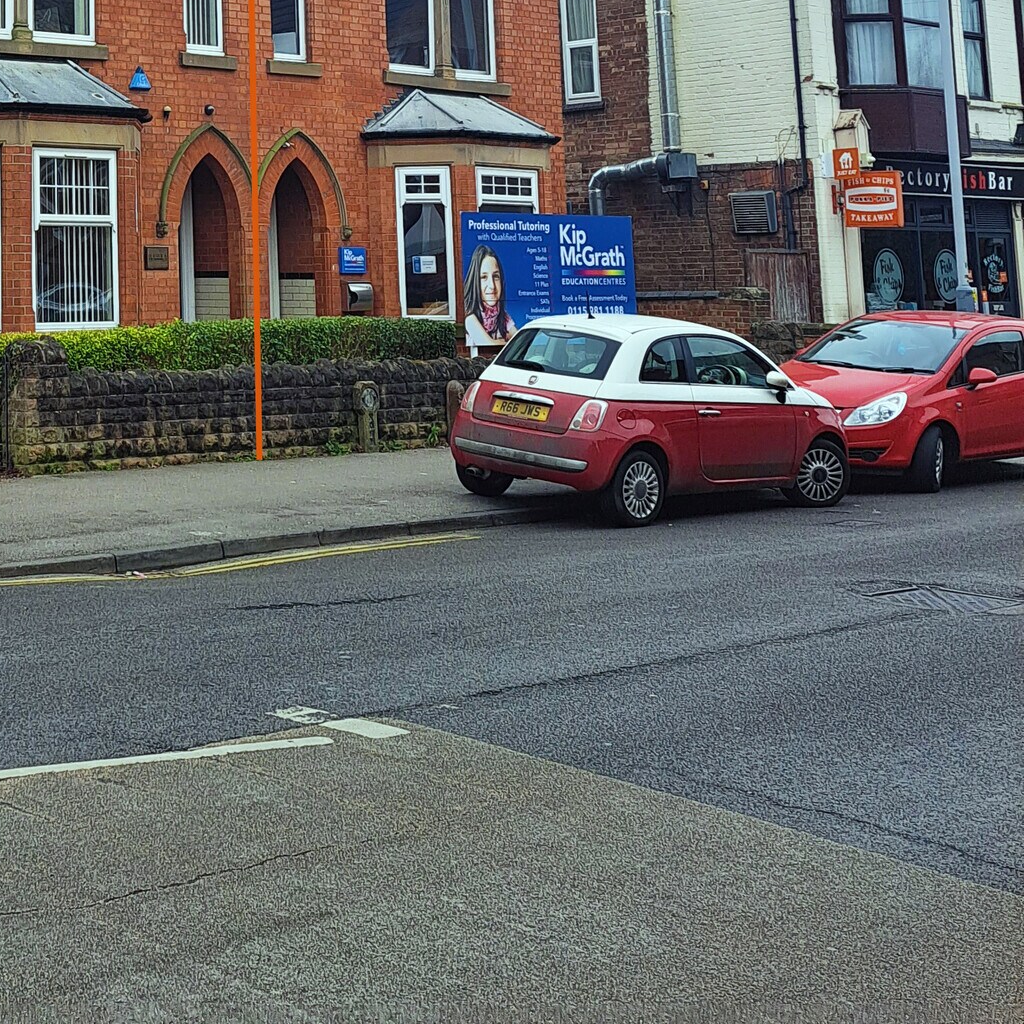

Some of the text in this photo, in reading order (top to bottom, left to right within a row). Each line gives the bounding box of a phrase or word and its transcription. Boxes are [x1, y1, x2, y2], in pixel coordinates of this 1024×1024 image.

[847, 177, 865, 186] FISH
[871, 176, 894, 185] CHIPS
[850, 213, 894, 222] TAKEAWAY
[468, 219, 550, 234] Professional Tutoring
[477, 232, 543, 242] with Qualified Teachers
[559, 223, 587, 252] Kip
[560, 245, 625, 266] McGrath
[615, 294, 628, 303] Today
[567, 306, 587, 315] 0115
[499, 401, 542, 417] R66 JWS
